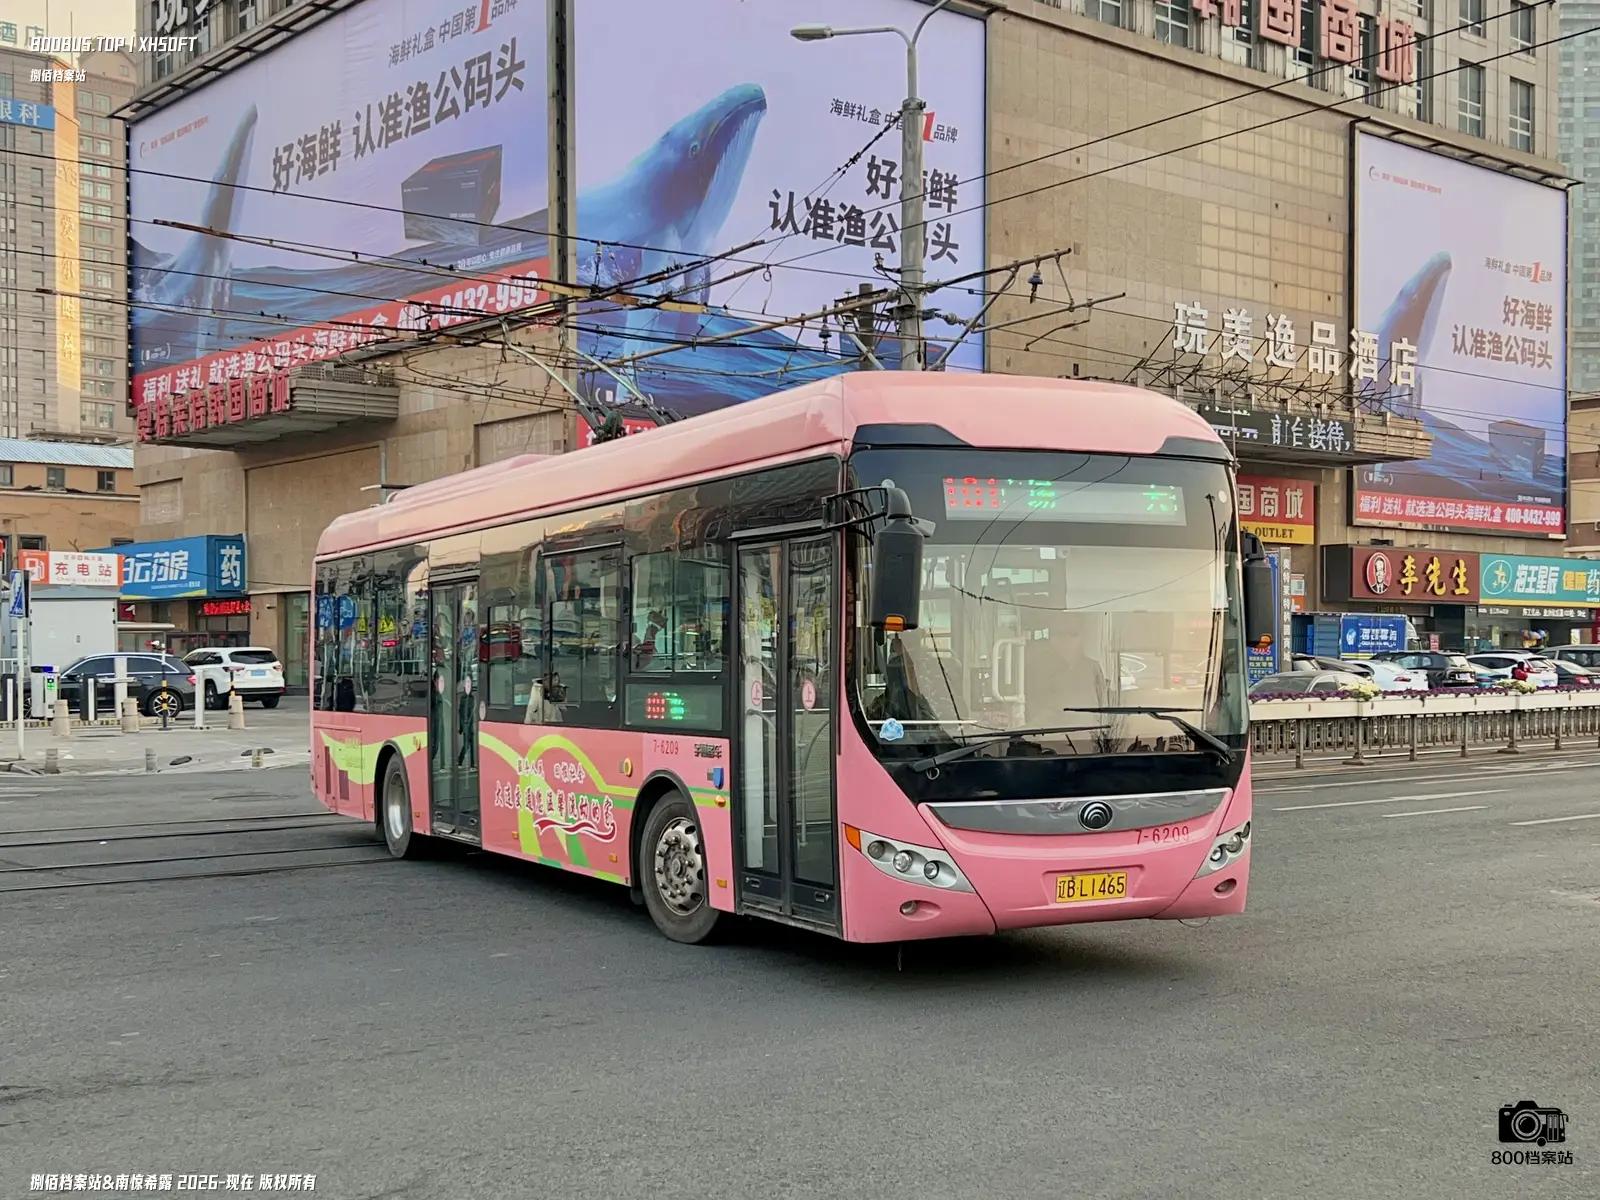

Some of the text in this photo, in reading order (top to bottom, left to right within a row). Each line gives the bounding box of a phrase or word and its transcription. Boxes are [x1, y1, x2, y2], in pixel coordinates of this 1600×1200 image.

[388, 26, 436, 69] 海鲜礼盒
[272, 36, 526, 195] 好海鲜 认准渔公码头
[830, 98, 959, 144] 海鲜礼盒 中1品牌
[865, 154, 959, 214] 好鲜
[768, 188, 959, 265] 认准渔公头
[1502, 295, 1553, 334] 好海鲜
[1452, 324, 1553, 370] 认准渔公码头
[142, 373, 171, 403] 福利
[175, 364, 204, 395] 送礼
[1237, 484, 1304, 519] 国商城
[1359, 495, 1381, 514] 福利
[1382, 496, 1403, 515] 送礼
[1405, 499, 1502, 523] 就选渔公码头海鲜礼盒
[1255, 527, 1295, 539] OUTLET
[55, 562, 113, 577] 充电站
[220, 545, 242, 588] 药
[1400, 554, 1471, 597] 李先生
[1513, 564, 1561, 595] 海王星辰
[653, 739, 679, 755] 7-6209
[1135, 825, 1190, 845] 7-6209
